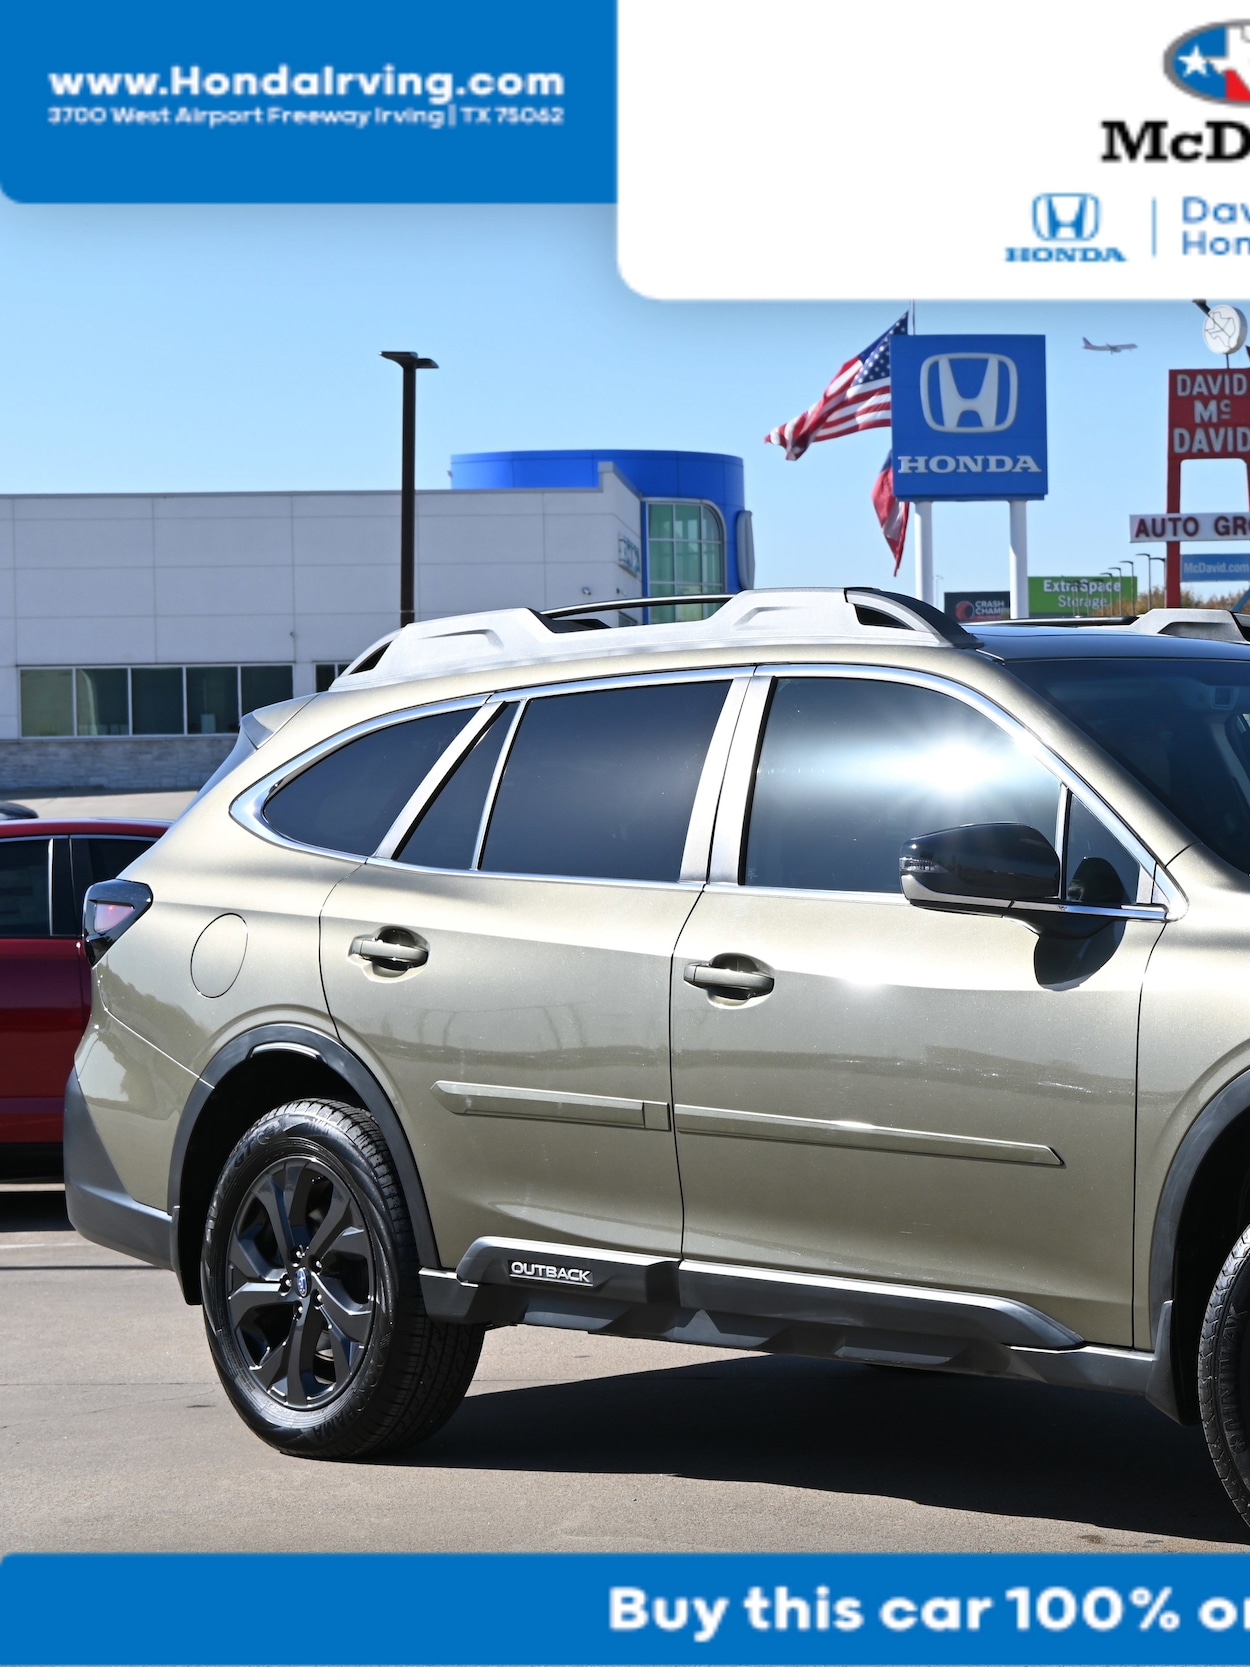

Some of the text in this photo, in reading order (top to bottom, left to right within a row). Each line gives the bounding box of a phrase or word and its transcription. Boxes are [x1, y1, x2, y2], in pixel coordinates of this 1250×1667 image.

[1176, 373, 1248, 397] DAVID
[898, 455, 1042, 474] HONDA
[1134, 516, 1200, 538] AUTO
[1184, 562, 1250, 574] McDavid.com
[975, 600, 1005, 608] CRASH
[1058, 595, 1108, 610] Storage
[511, 1261, 591, 1283] OUTBACK
